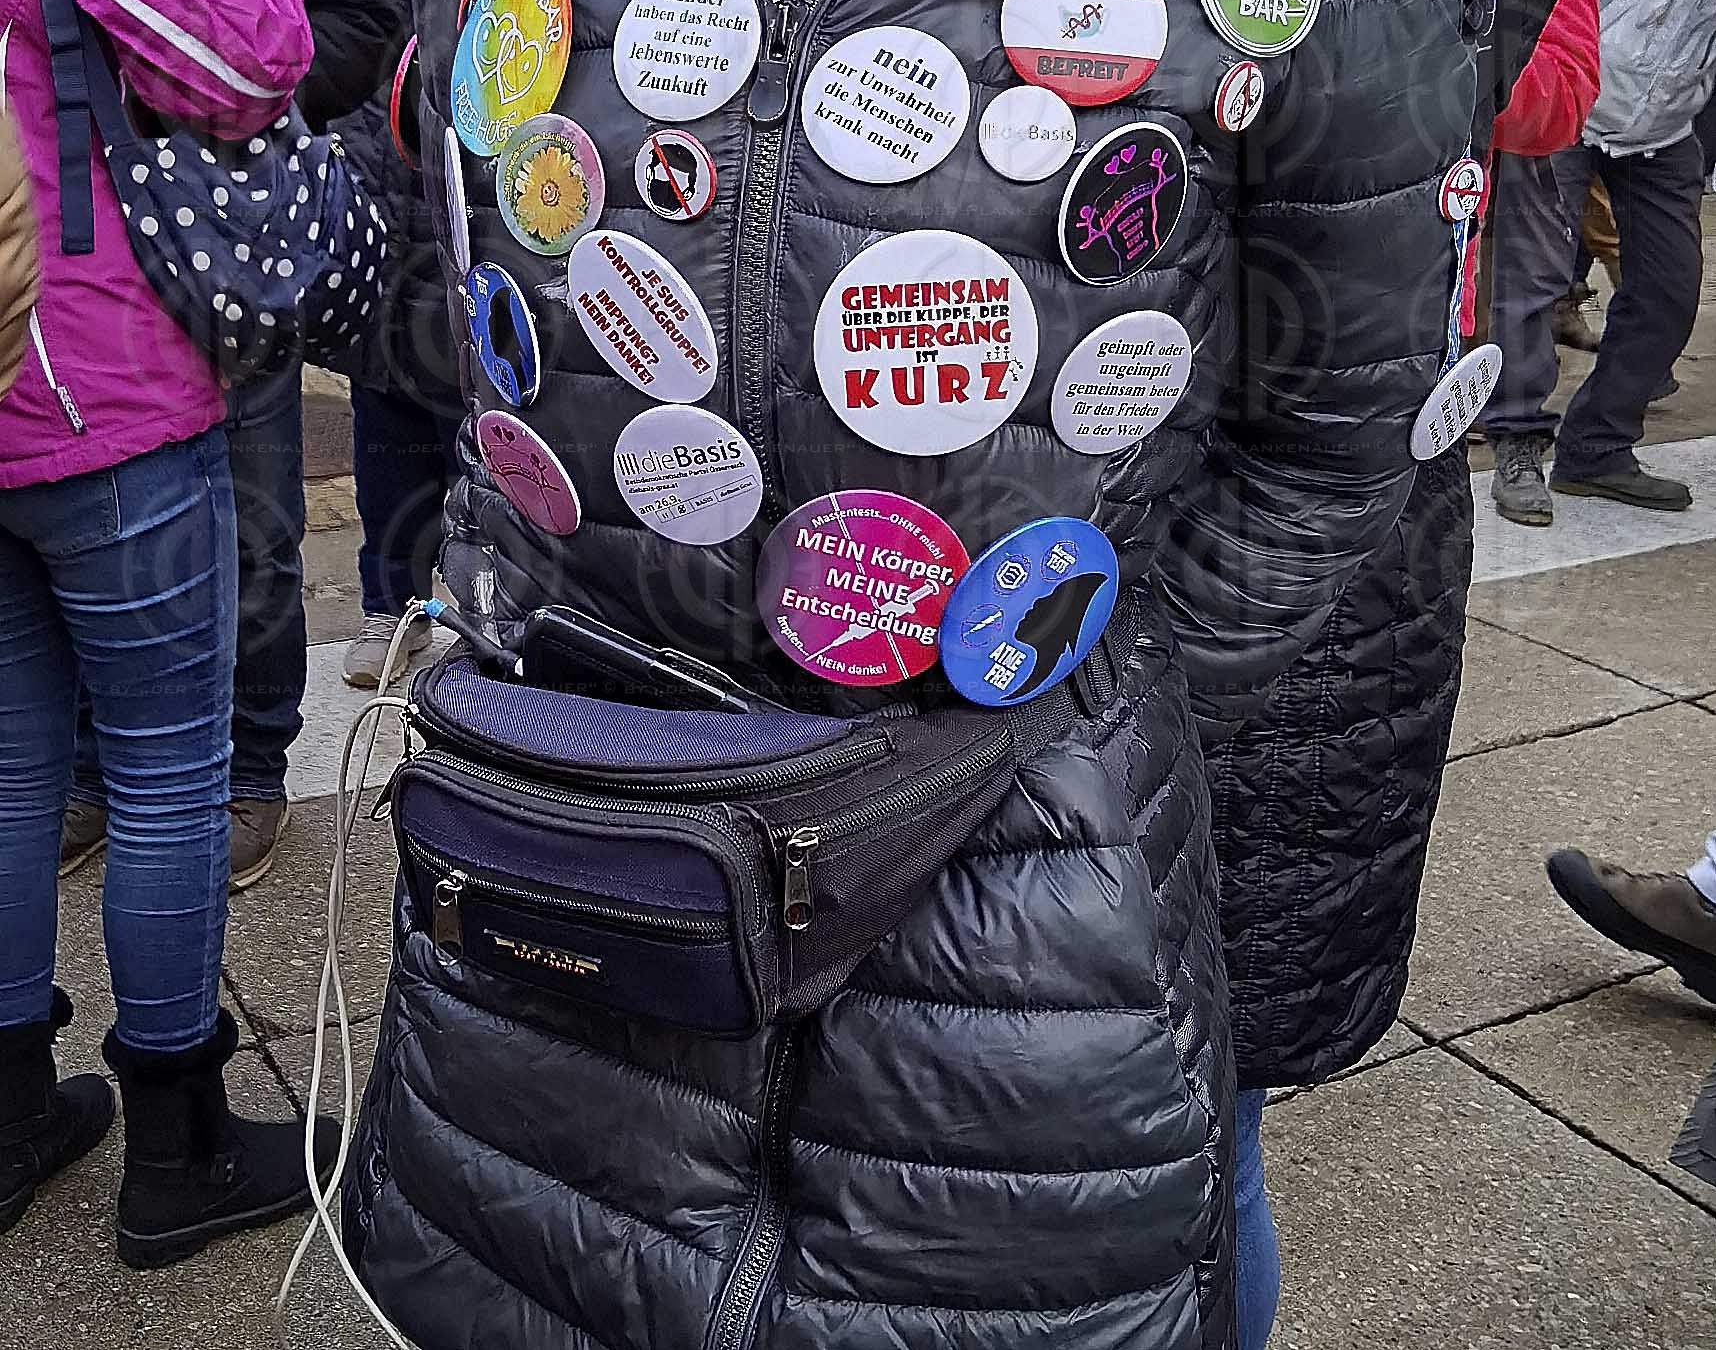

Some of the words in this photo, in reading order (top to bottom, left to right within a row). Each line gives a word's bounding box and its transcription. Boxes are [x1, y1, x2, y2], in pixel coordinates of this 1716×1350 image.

[634, 4, 675, 22] haben
[679, 9, 703, 25] das
[706, 12, 750, 32] Recht
[654, 29, 680, 43] auf
[681, 31, 712, 47] eine
[629, 42, 730, 72] lebenswerte
[872, 48, 938, 91] nein
[1037, 55, 1130, 81] BEFREIT
[455, 78, 480, 134] FREE
[827, 59, 858, 78] zur
[859, 69, 956, 128] Unwahrheit
[824, 81, 849, 102] die
[851, 92, 934, 144] Menschen
[814, 101, 863, 136] krank
[867, 130, 920, 164] macht
[596, 235, 712, 375] KONTROLLGRUPPE!
[641, 269, 662, 289] JE
[656, 284, 690, 322] SUIS
[841, 278, 1010, 311] GEMEINSAM
[595, 288, 660, 365] IMPFUNG?
[841, 310, 883, 327] ÜBER
[886, 310, 912, 324] DIE
[916, 306, 976, 322] KLIPPE,
[979, 304, 1010, 319] DER
[578, 291, 612, 333] NEIN
[606, 329, 655, 385] DANKE!
[842, 319, 1011, 352] UNTERGANG
[1096, 339, 1156, 360] geimpft
[1158, 343, 1186, 356] oder
[916, 349, 939, 364] IST
[1099, 362, 1173, 381] ungeimpft
[1065, 382, 1147, 398] gemeinsam
[1149, 384, 1180, 397] beten
[1072, 401, 1093, 415] für
[1093, 402, 1115, 416] den
[1116, 402, 1160, 417] Frieden
[1076, 423, 1090, 435] in
[1092, 423, 1115, 436] der
[1117, 424, 1144, 436] Welt
[641, 438, 741, 473] dieBasis
[639, 503, 655, 515] am
[795, 528, 866, 563] MEIN
[870, 546, 956, 586] Körper,
[918, 534, 945, 560] mich!
[826, 567, 912, 604] MEINE
[781, 586, 937, 646] Entscheidung
[816, 654, 846, 672] NEIN
[847, 662, 888, 676] danke!
[988, 641, 1028, 672] ATME
[983, 662, 1016, 691] FREI
